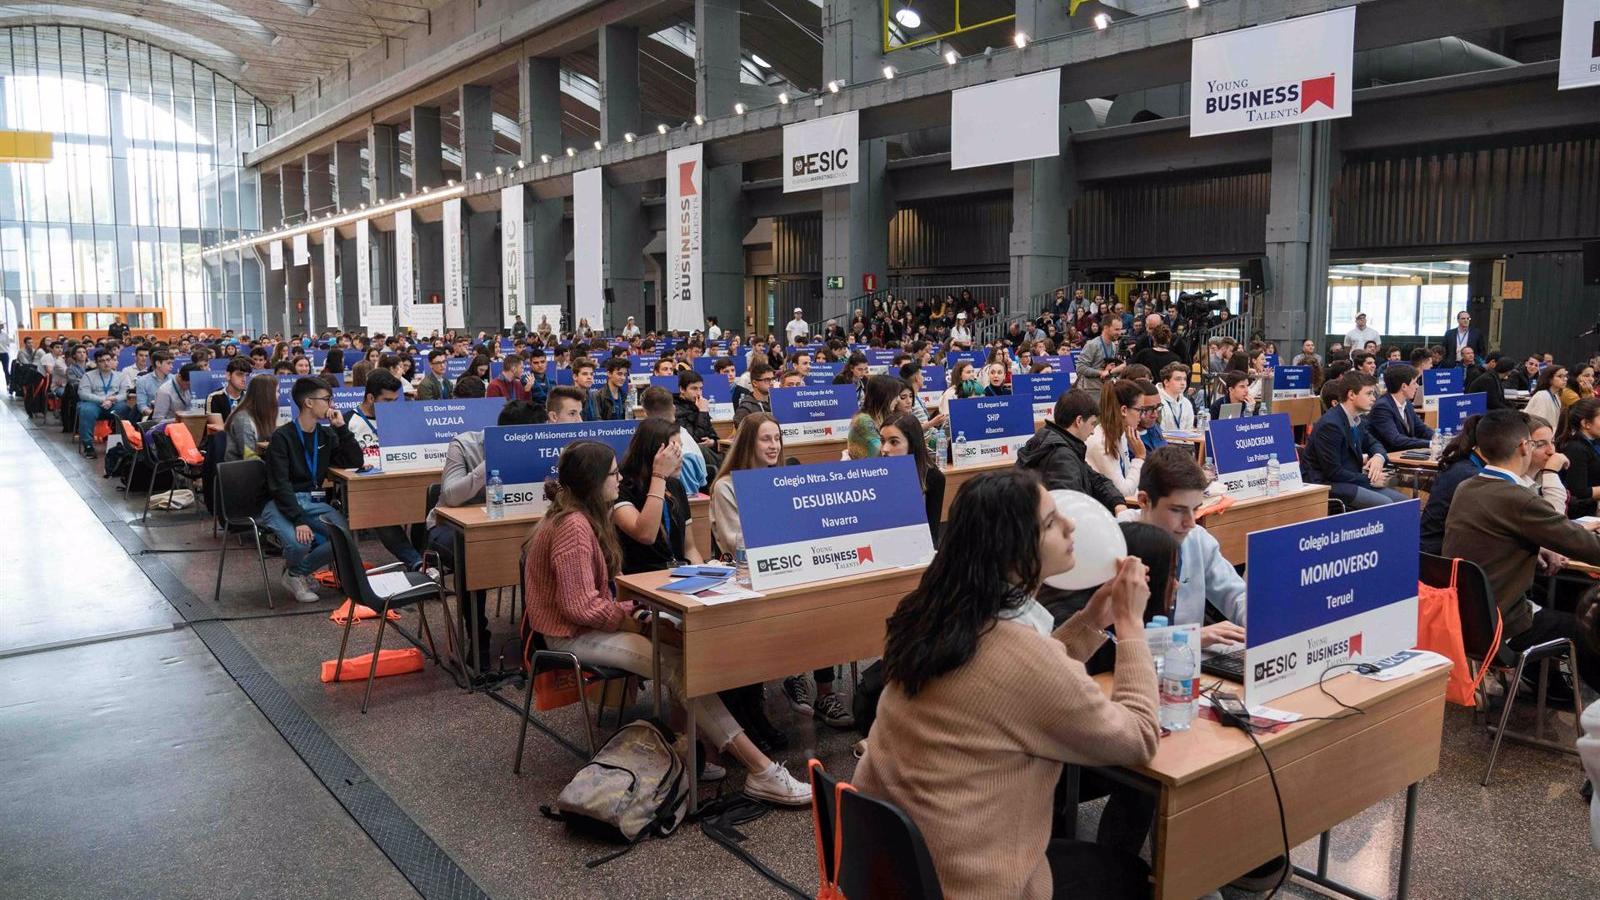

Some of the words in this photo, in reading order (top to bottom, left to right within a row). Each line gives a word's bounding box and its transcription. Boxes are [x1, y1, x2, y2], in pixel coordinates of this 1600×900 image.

[1207, 79, 1249, 93] YOUNG
[1206, 84, 1299, 114] BUSINESS
[1246, 107, 1299, 122] TALENTS
[806, 148, 848, 175] ESIC
[506, 220, 517, 289] ESIC
[681, 198, 691, 300] BUSINESS
[792, 399, 838, 409] INTERDEMELON
[984, 401, 1000, 409] Amparo
[425, 416, 465, 426] VALZALA
[986, 413, 1000, 422] SHIP
[504, 432, 533, 443] Colegio
[535, 430, 577, 440] Misioneras
[577, 429, 588, 438] de
[589, 428, 597, 437] la
[598, 427, 636, 438] Providenci
[1236, 423, 1250, 432] Colegio
[980, 445, 1002, 455] BUSINESS
[1235, 435, 1274, 450] SQUADCREAM
[394, 452, 417, 461] ESIC
[1254, 453, 1269, 462] Palmas
[773, 475, 806, 488] Colegio
[807, 472, 829, 484] Ntra.
[829, 471, 846, 481] Sra.
[847, 468, 860, 479] del
[860, 467, 889, 478] Huerto
[1228, 479, 1244, 491] ESIC
[504, 491, 534, 503] ESIC
[792, 488, 877, 510] DESUBIKADAS
[821, 515, 858, 528] Navarra
[1299, 532, 1330, 552] Colegio
[1330, 531, 1340, 545] La
[1340, 520, 1384, 542] Inmaculada
[770, 554, 803, 571] ESIC
[812, 549, 858, 566] BUSINESS
[1300, 550, 1379, 587] MOMOVERSO
[1326, 588, 1354, 609] Teruel
[1306, 639, 1349, 666] BUSINESS
[1265, 651, 1298, 678] ESIC
